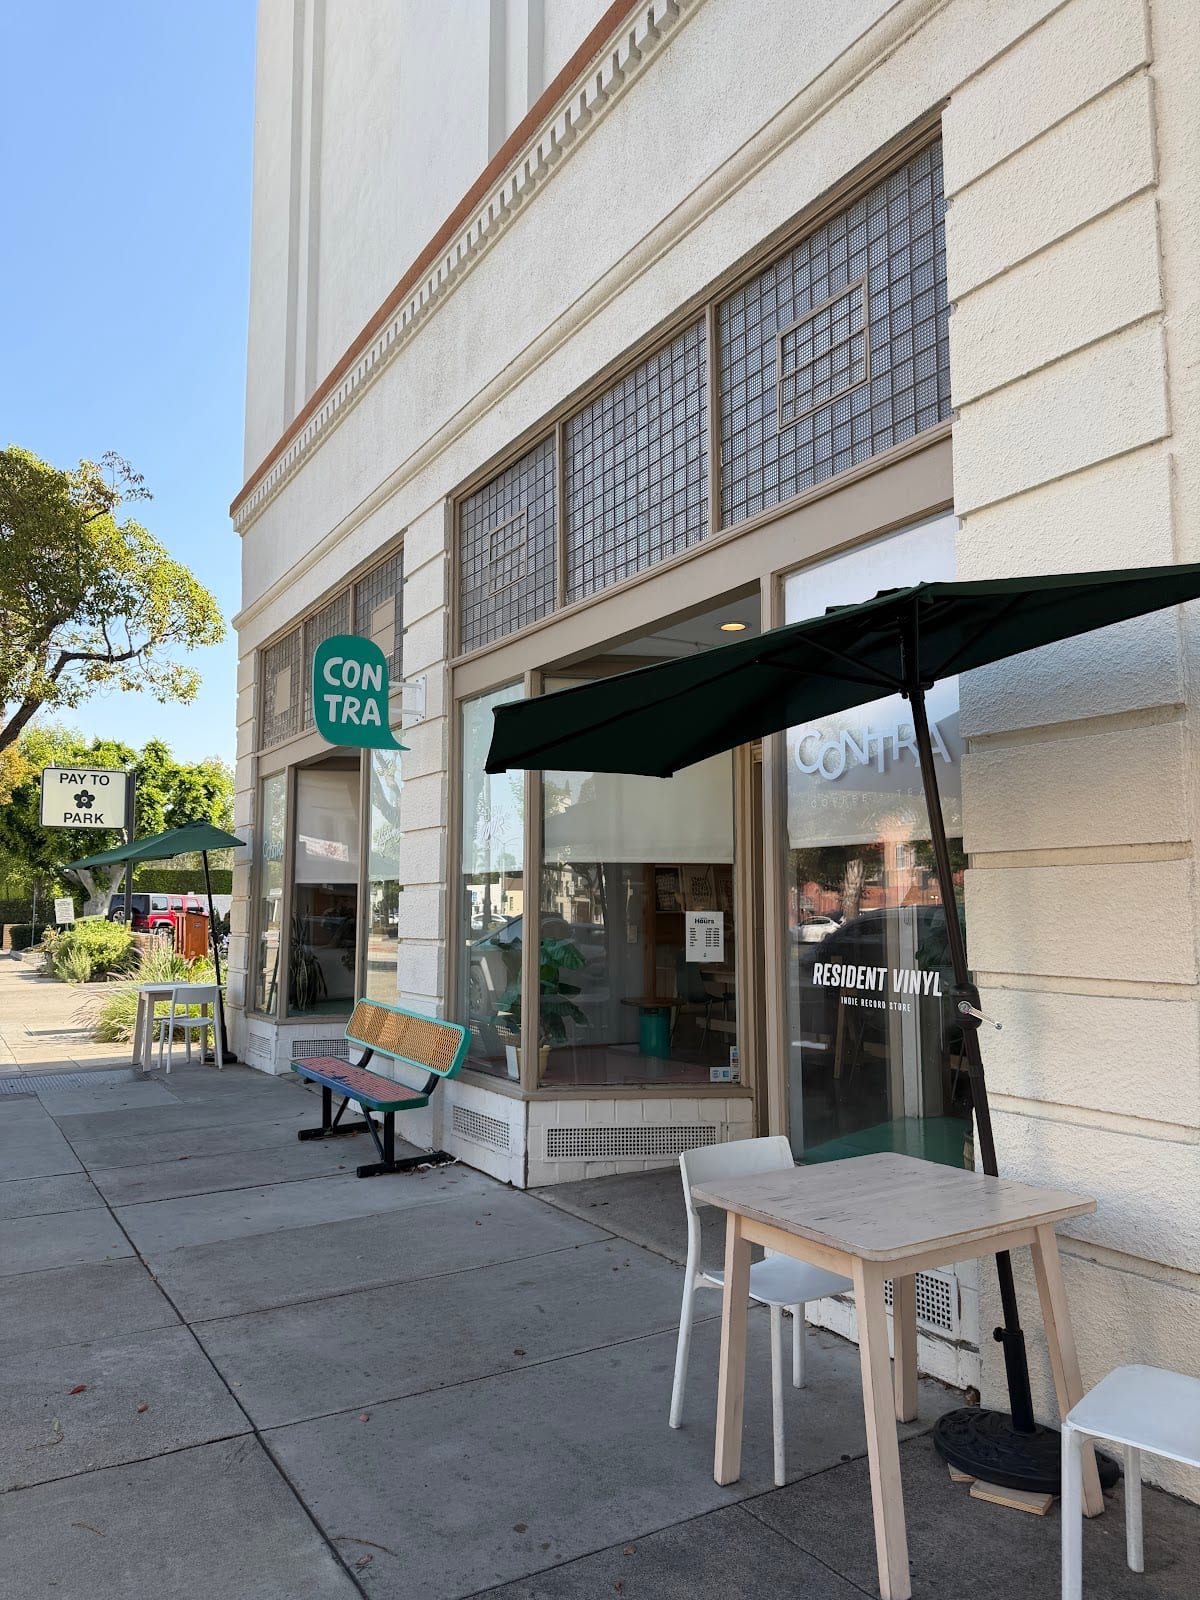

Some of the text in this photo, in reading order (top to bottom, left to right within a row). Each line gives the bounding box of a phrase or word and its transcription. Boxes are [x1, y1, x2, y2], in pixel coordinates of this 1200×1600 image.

[322, 656, 383, 692] CON
[323, 694, 382, 726] TRA
[794, 721, 953, 781] CONTRA
[59, 773, 110, 786] PAY TO
[63, 812, 105, 825] PARK
[812, 962, 943, 997] RESIDENT VINYL
[840, 996, 912, 1012] INDIE RECORD STORE
